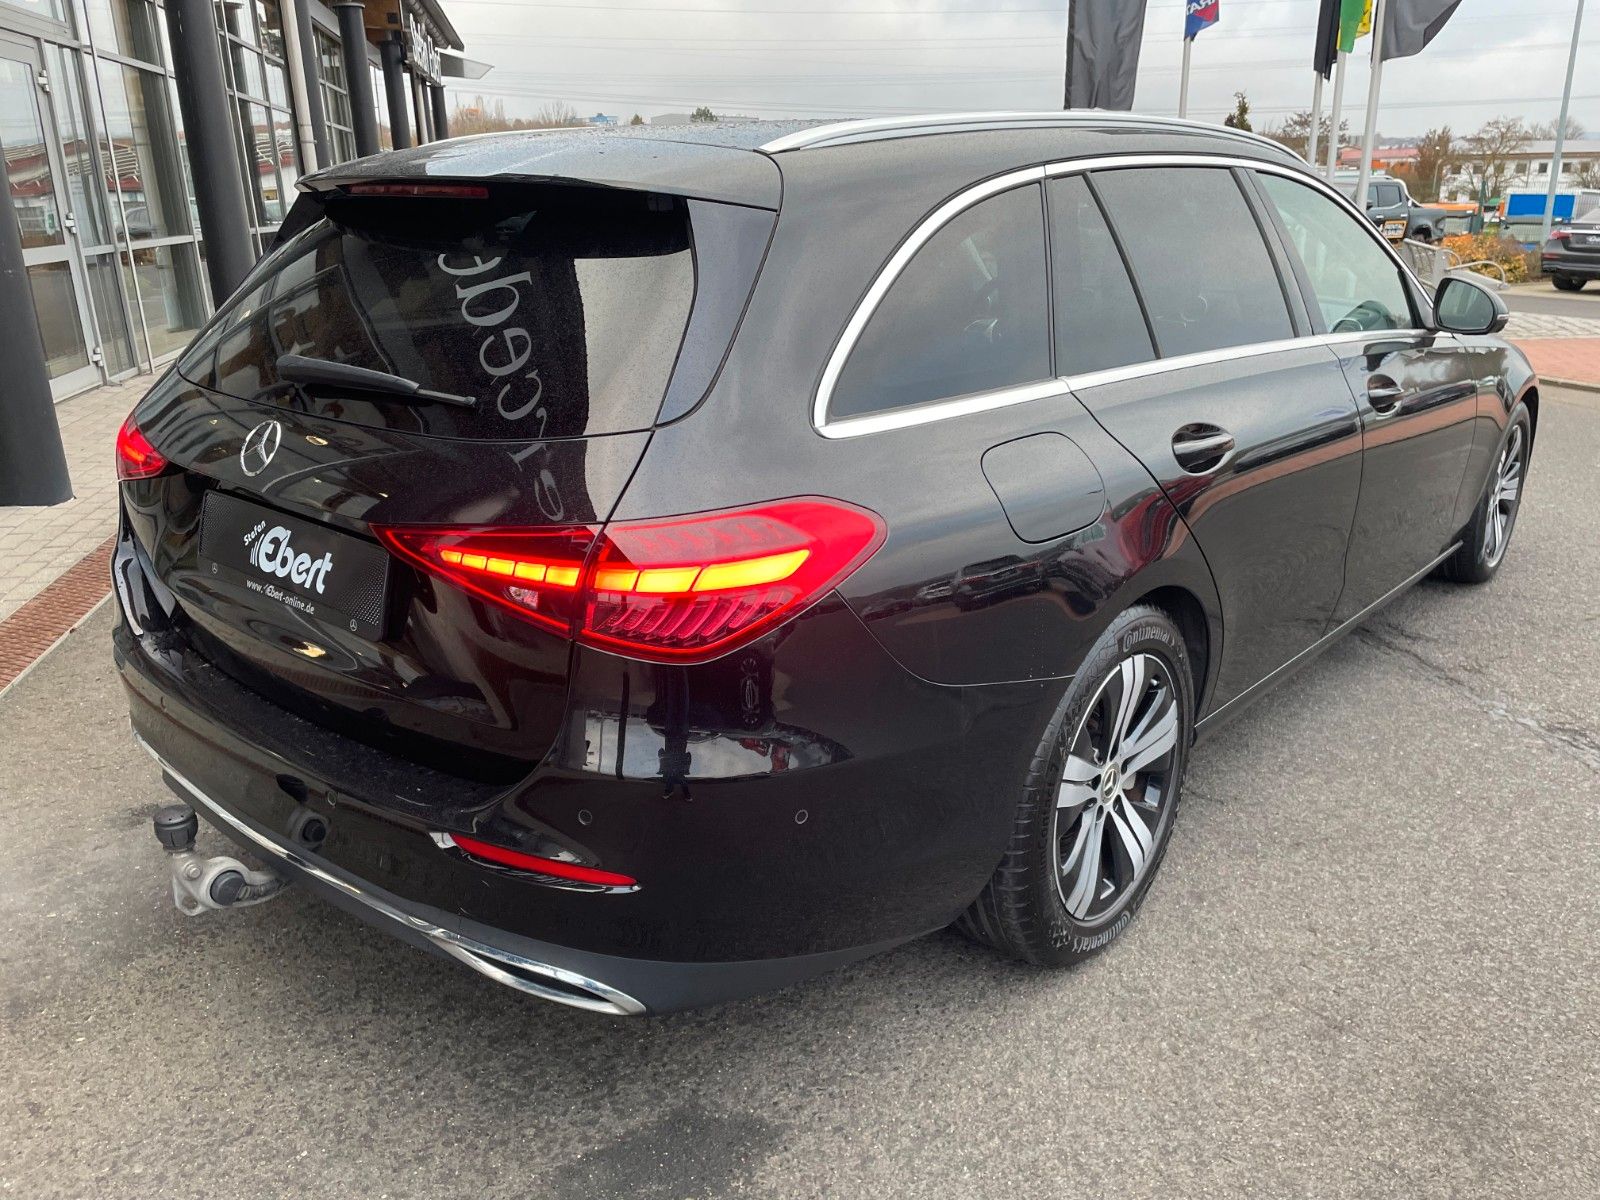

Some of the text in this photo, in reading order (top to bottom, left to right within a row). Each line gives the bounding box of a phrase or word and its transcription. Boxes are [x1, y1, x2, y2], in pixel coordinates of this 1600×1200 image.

[243, 520, 266, 546] Stefan
[258, 526, 333, 594] Ebert
[1122, 626, 1170, 653] Continental
[1077, 910, 1131, 953] Continental
